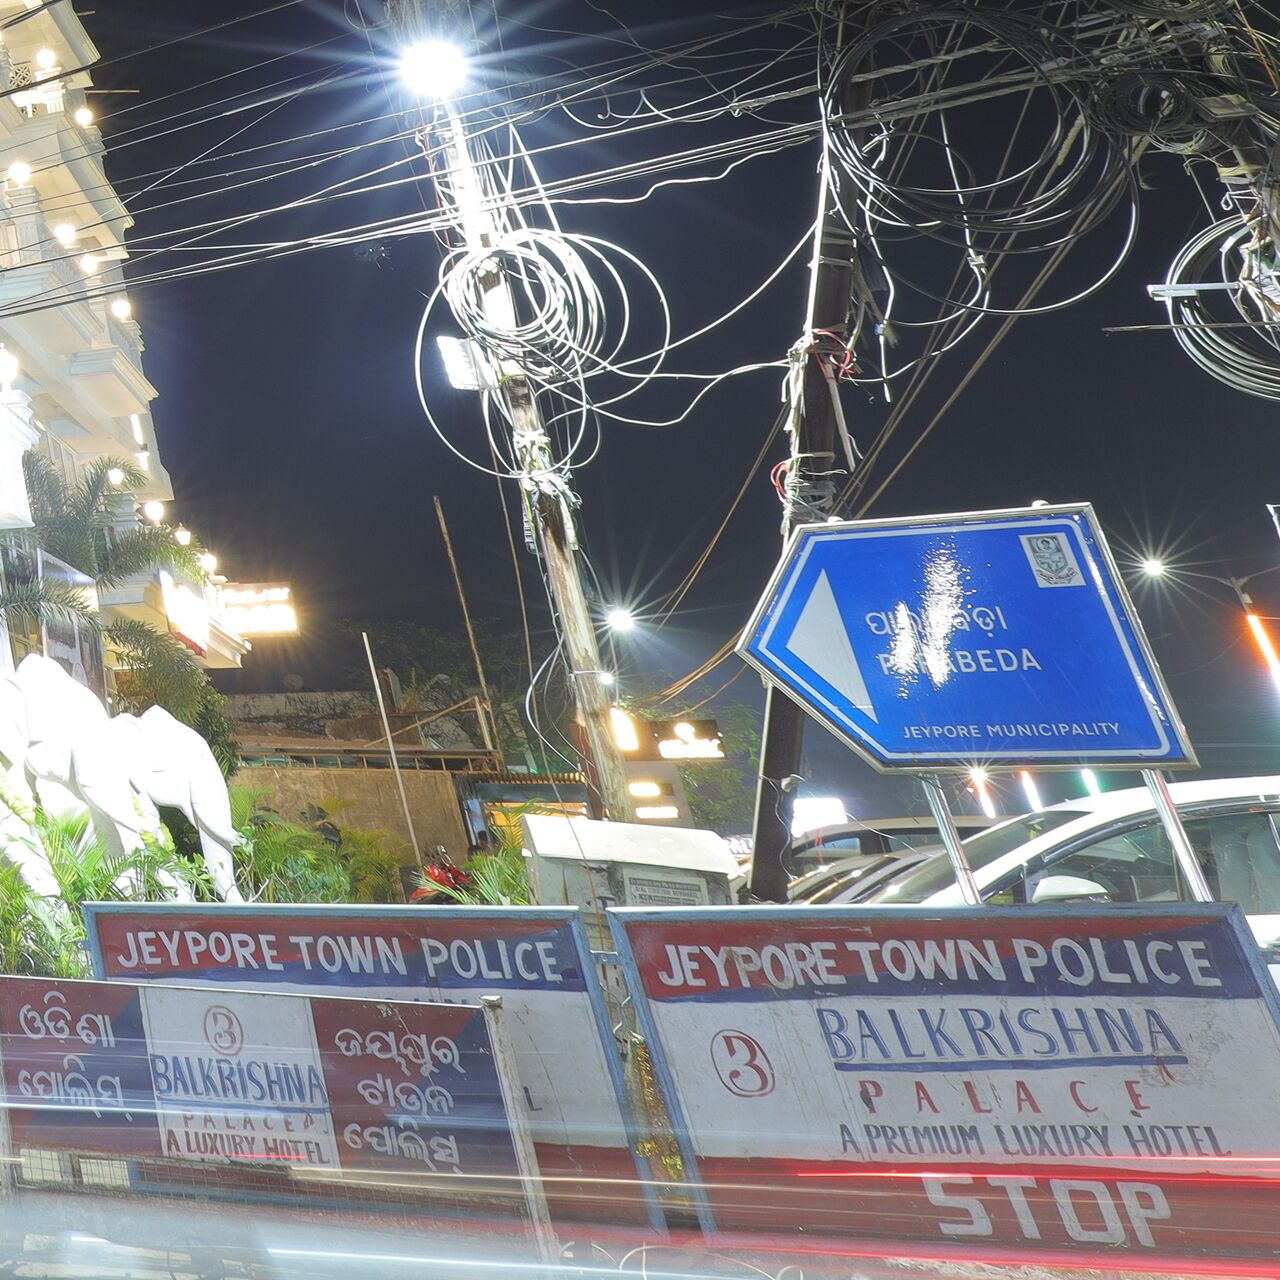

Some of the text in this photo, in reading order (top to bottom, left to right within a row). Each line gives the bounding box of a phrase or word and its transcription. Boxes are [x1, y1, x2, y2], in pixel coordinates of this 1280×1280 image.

[903, 721, 1121, 740] JEYPORE MUNICIPALITY
[117, 929, 563, 983] JEYPORE TOWN POLICE
[658, 937, 1222, 990] JEYPORE TOWN POLICE
[816, 1006, 1183, 1062] BALKRISHNA
[150, 1053, 329, 1104] BALKRISHNA
[858, 1078, 1151, 1115] PALACE
[182, 1110, 295, 1133] PALACE
[841, 1122, 1233, 1157] A PREMIUM LUXURY HOTEL
[166, 1128, 331, 1164] A LUXURY HOTEL
[924, 1172, 1172, 1248] STOP
